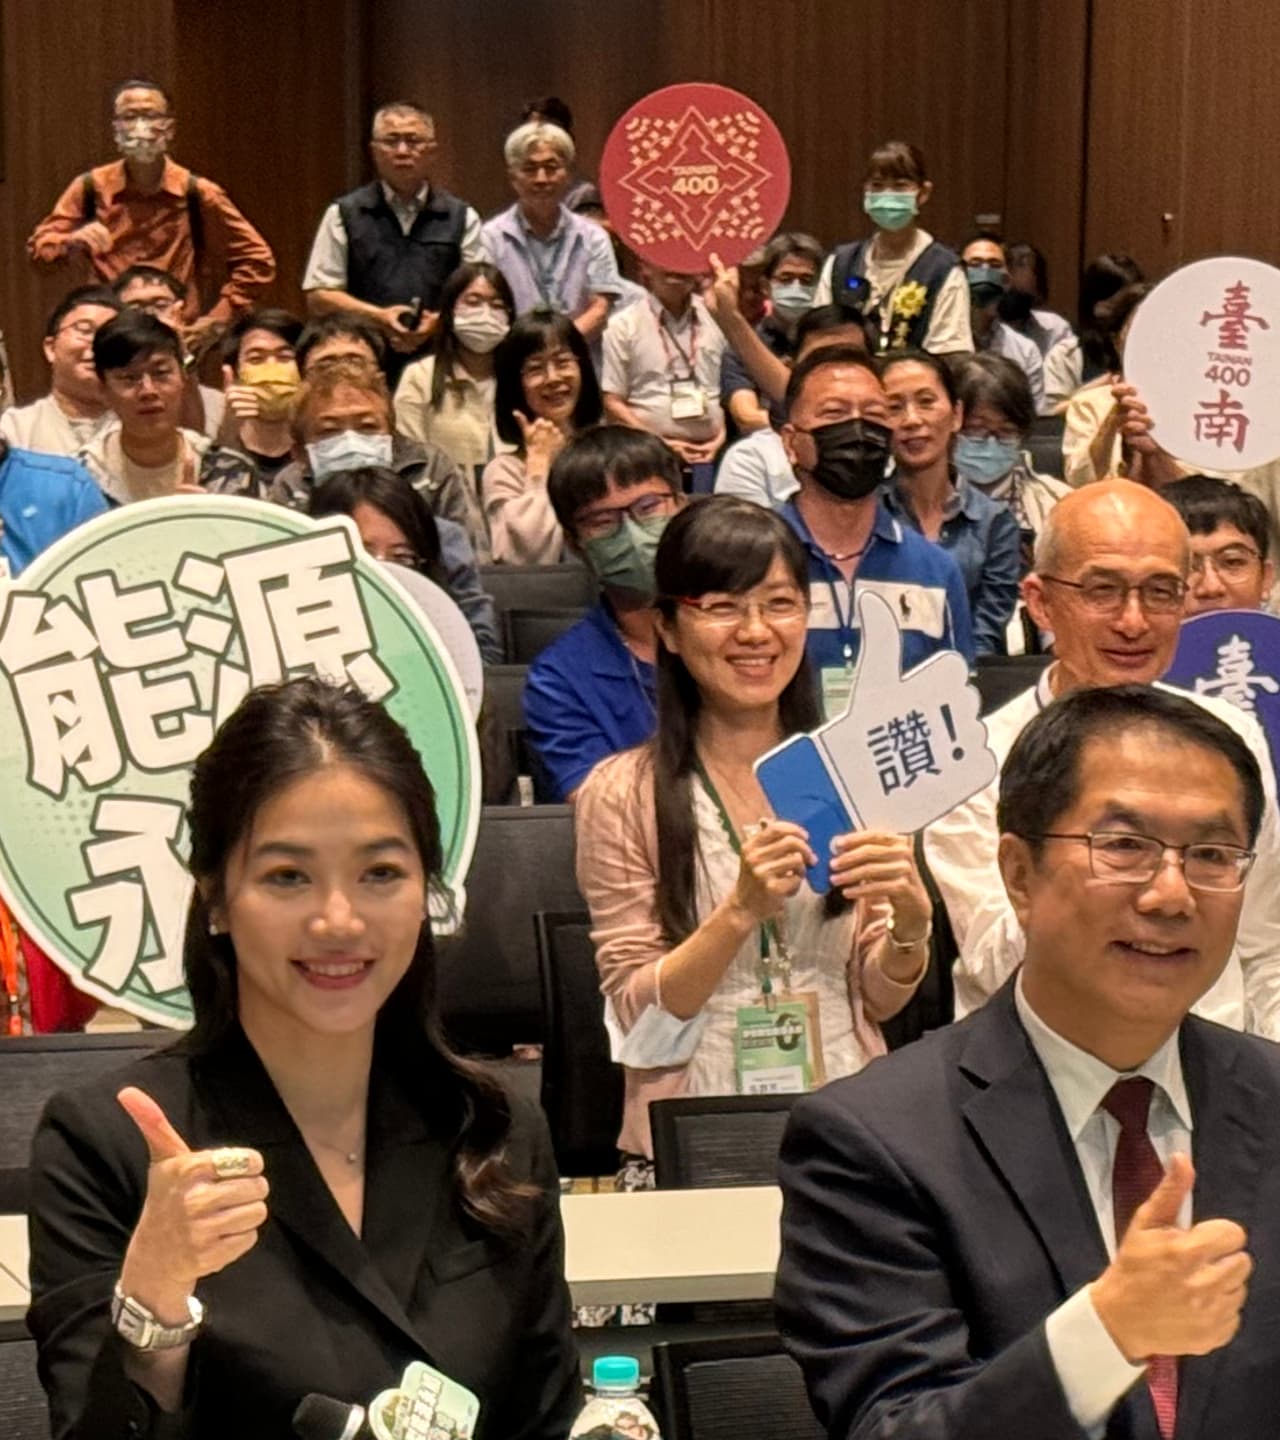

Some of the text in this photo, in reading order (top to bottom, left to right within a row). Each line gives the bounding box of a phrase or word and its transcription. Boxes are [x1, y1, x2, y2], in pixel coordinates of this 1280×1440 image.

[671, 175, 719, 195] 400
[1199, 280, 1270, 350] 臺
[1204, 366, 1251, 387] 400
[1193, 388, 1250, 453] 南
